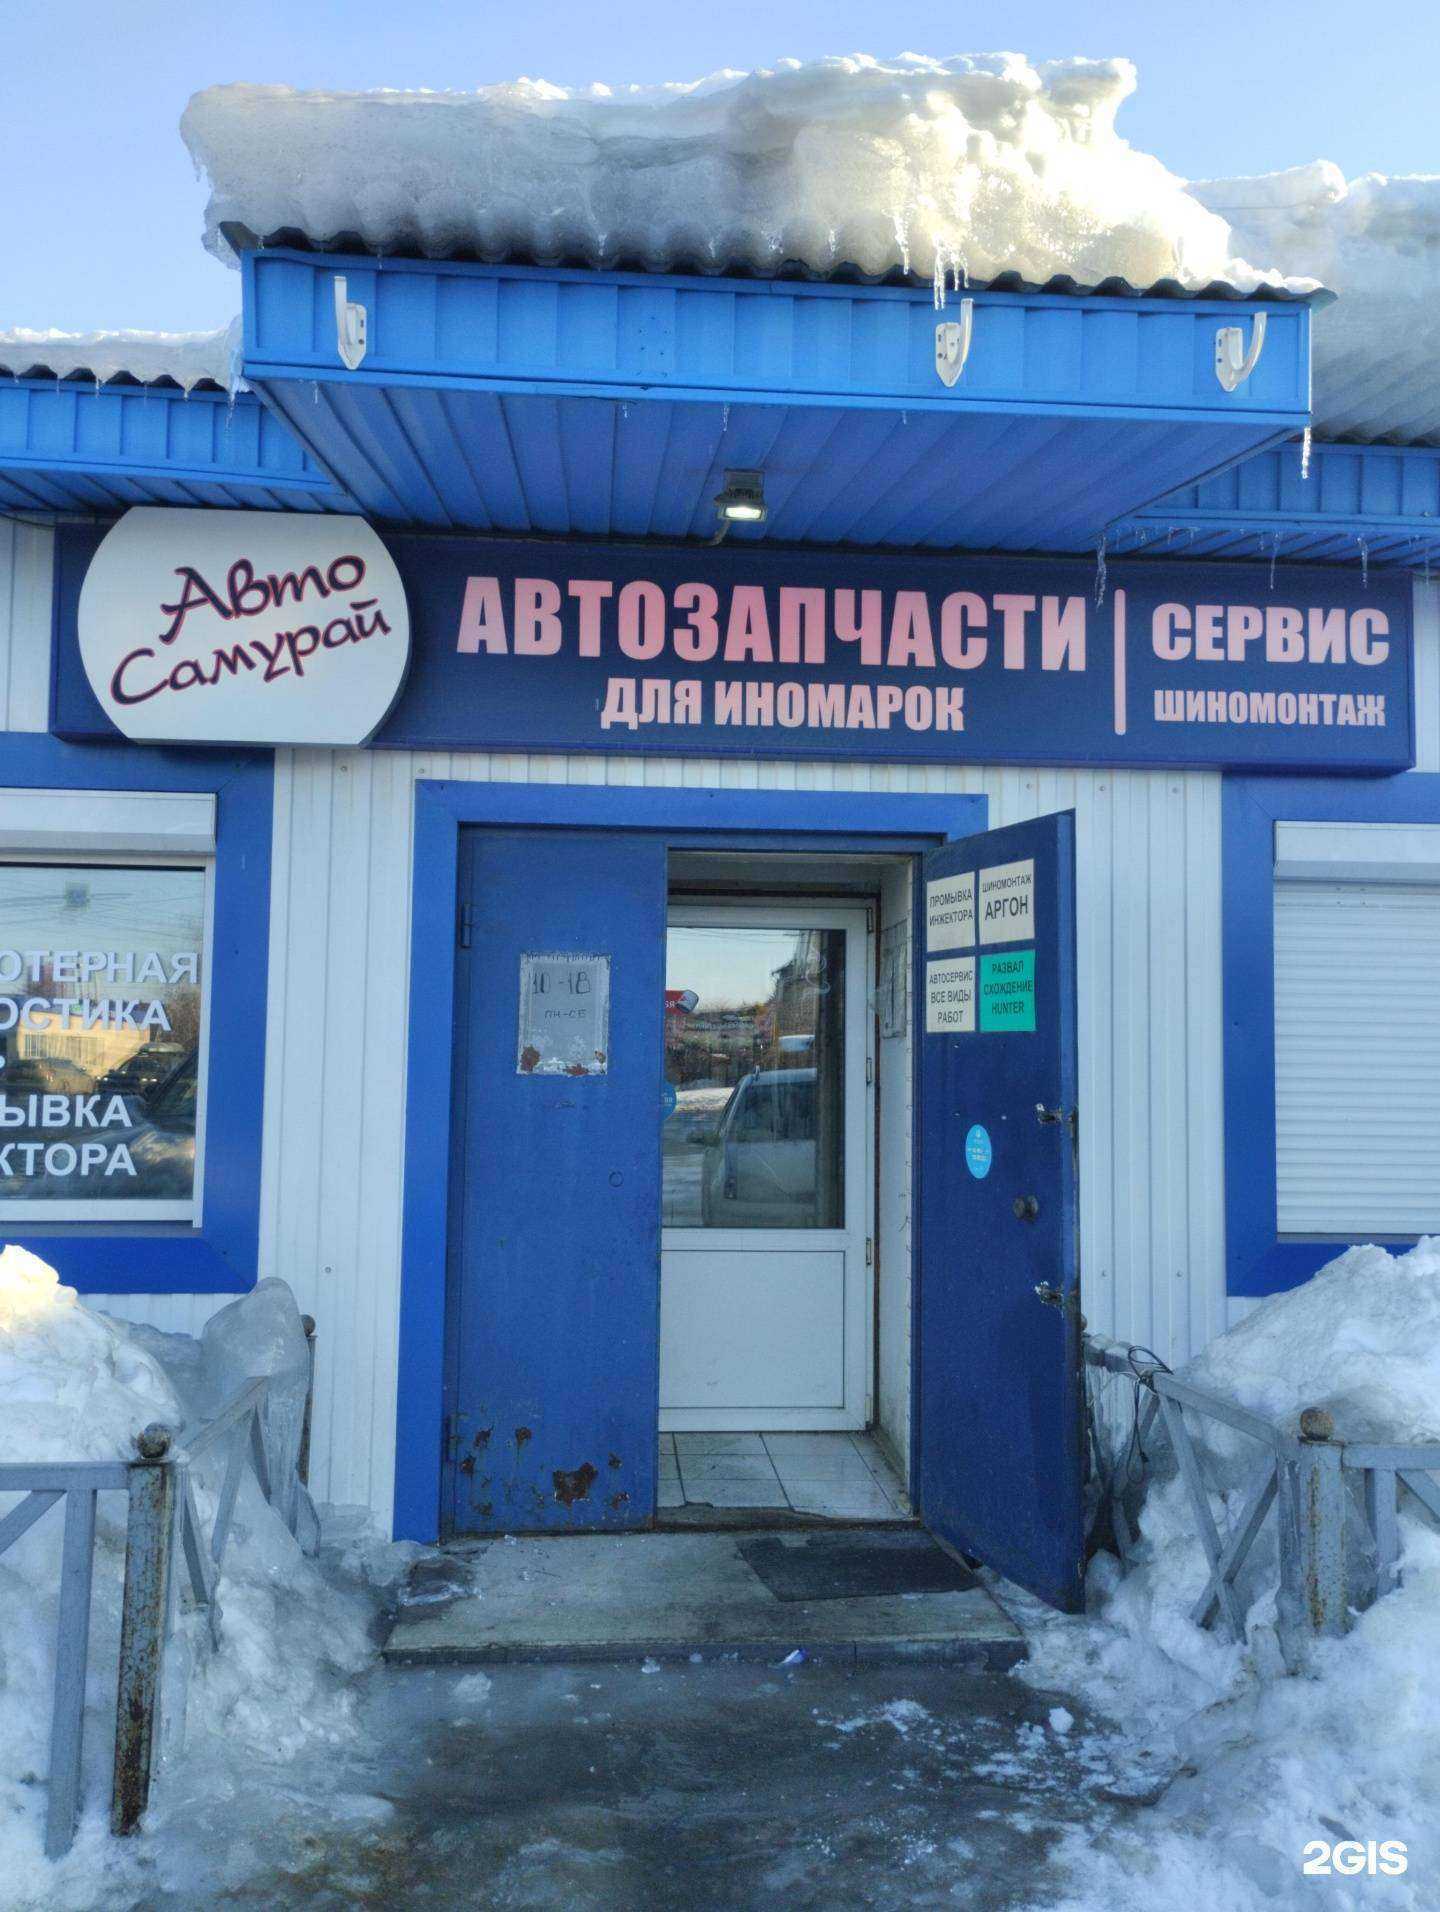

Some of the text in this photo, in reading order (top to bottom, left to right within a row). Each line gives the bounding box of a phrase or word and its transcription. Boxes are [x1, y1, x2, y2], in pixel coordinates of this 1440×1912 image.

[159, 554, 366, 645] Авто
[456, 577, 1086, 672] АВТОЗАПЧАСТИ
[1151, 602, 1390, 666] СЕРВИС
[110, 598, 392, 706] Самурай
[600, 677, 965, 732] ДЛЯ ИНОМАРОК
[1153, 689, 1387, 727] ШИНОМОНТАЖ
[982, 874, 1032, 893] ШИНОМОНТАЖ
[930, 888, 973, 908] ПРОМЫВКА
[985, 895, 1028, 921] АРГОН
[929, 912, 973, 927] ИНЖЕКТОРА
[991, 959, 1024, 975] РАЗВАЛ
[929, 970, 973, 985] АВТОСЕРВИС
[930, 988, 972, 1004] ВСЕ ВИДЫ
[937, 1010, 964, 1025] РАБОТ
[991, 1001, 1025, 1016] HUNTER
